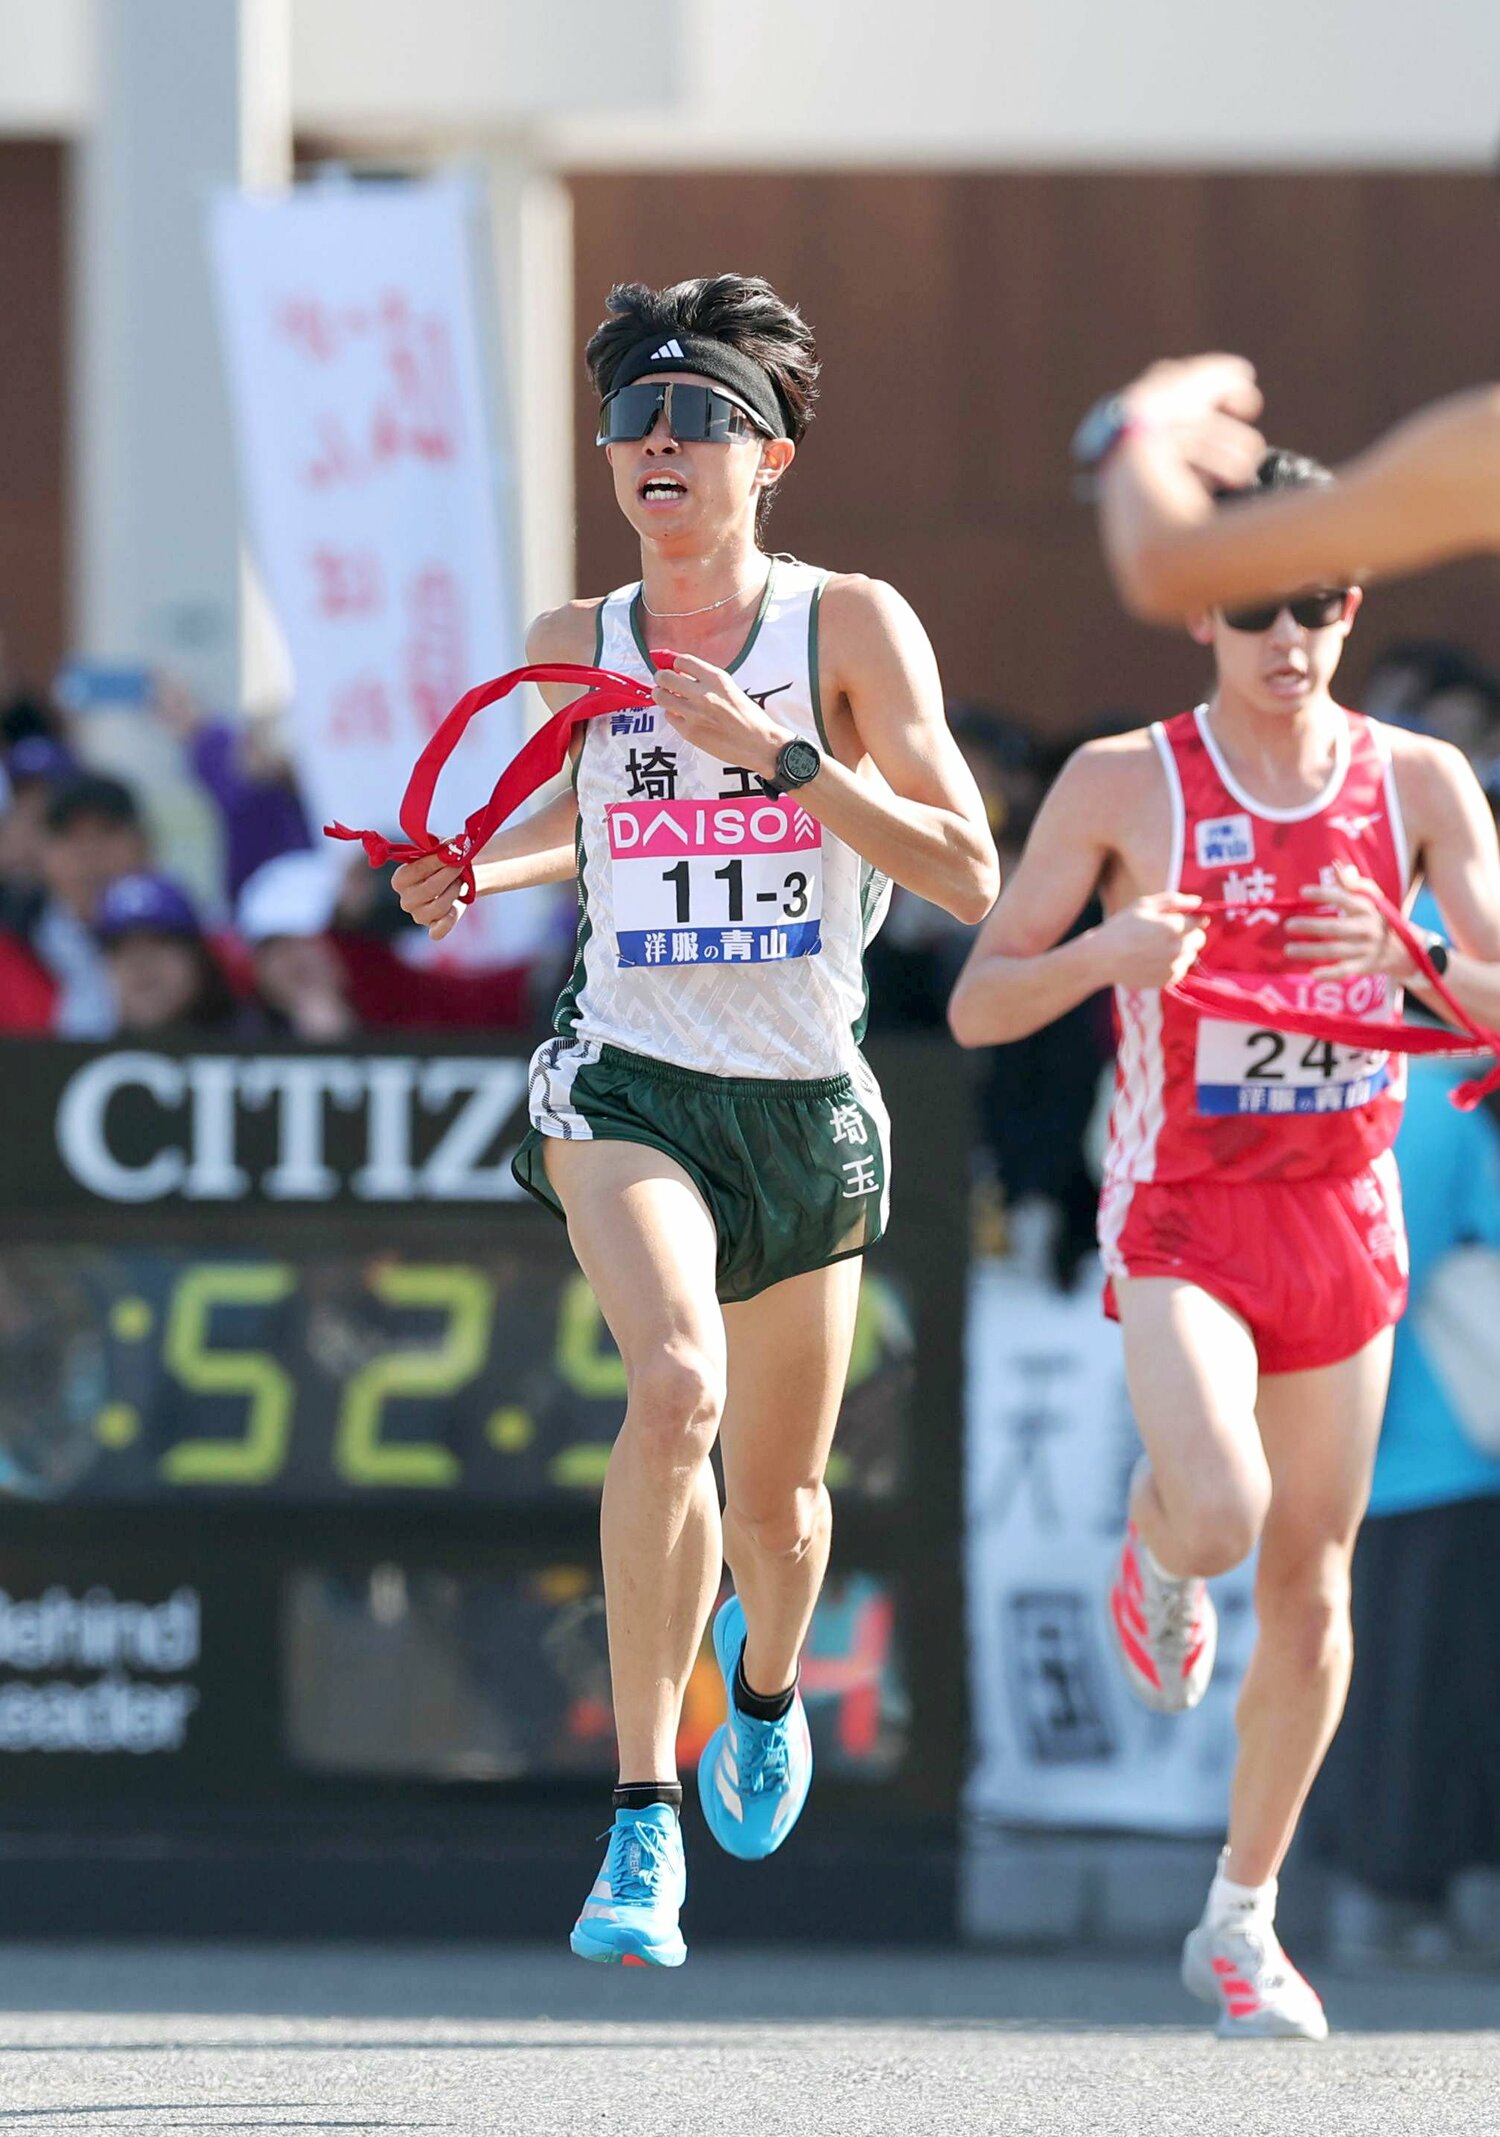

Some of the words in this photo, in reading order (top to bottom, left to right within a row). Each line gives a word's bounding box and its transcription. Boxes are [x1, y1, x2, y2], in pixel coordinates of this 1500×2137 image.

[610, 713, 654, 736] 青山
[612, 806, 789, 849] DAISO
[662, 859, 808, 923] 11-3
[644, 929, 787, 963] 洋服の青山
[1214, 976, 1373, 1014] AISO
[1245, 1030, 1374, 1079] 24-
[829, 1103, 880, 1199] 埼玉
[0, 1586, 200, 1670] ehind
